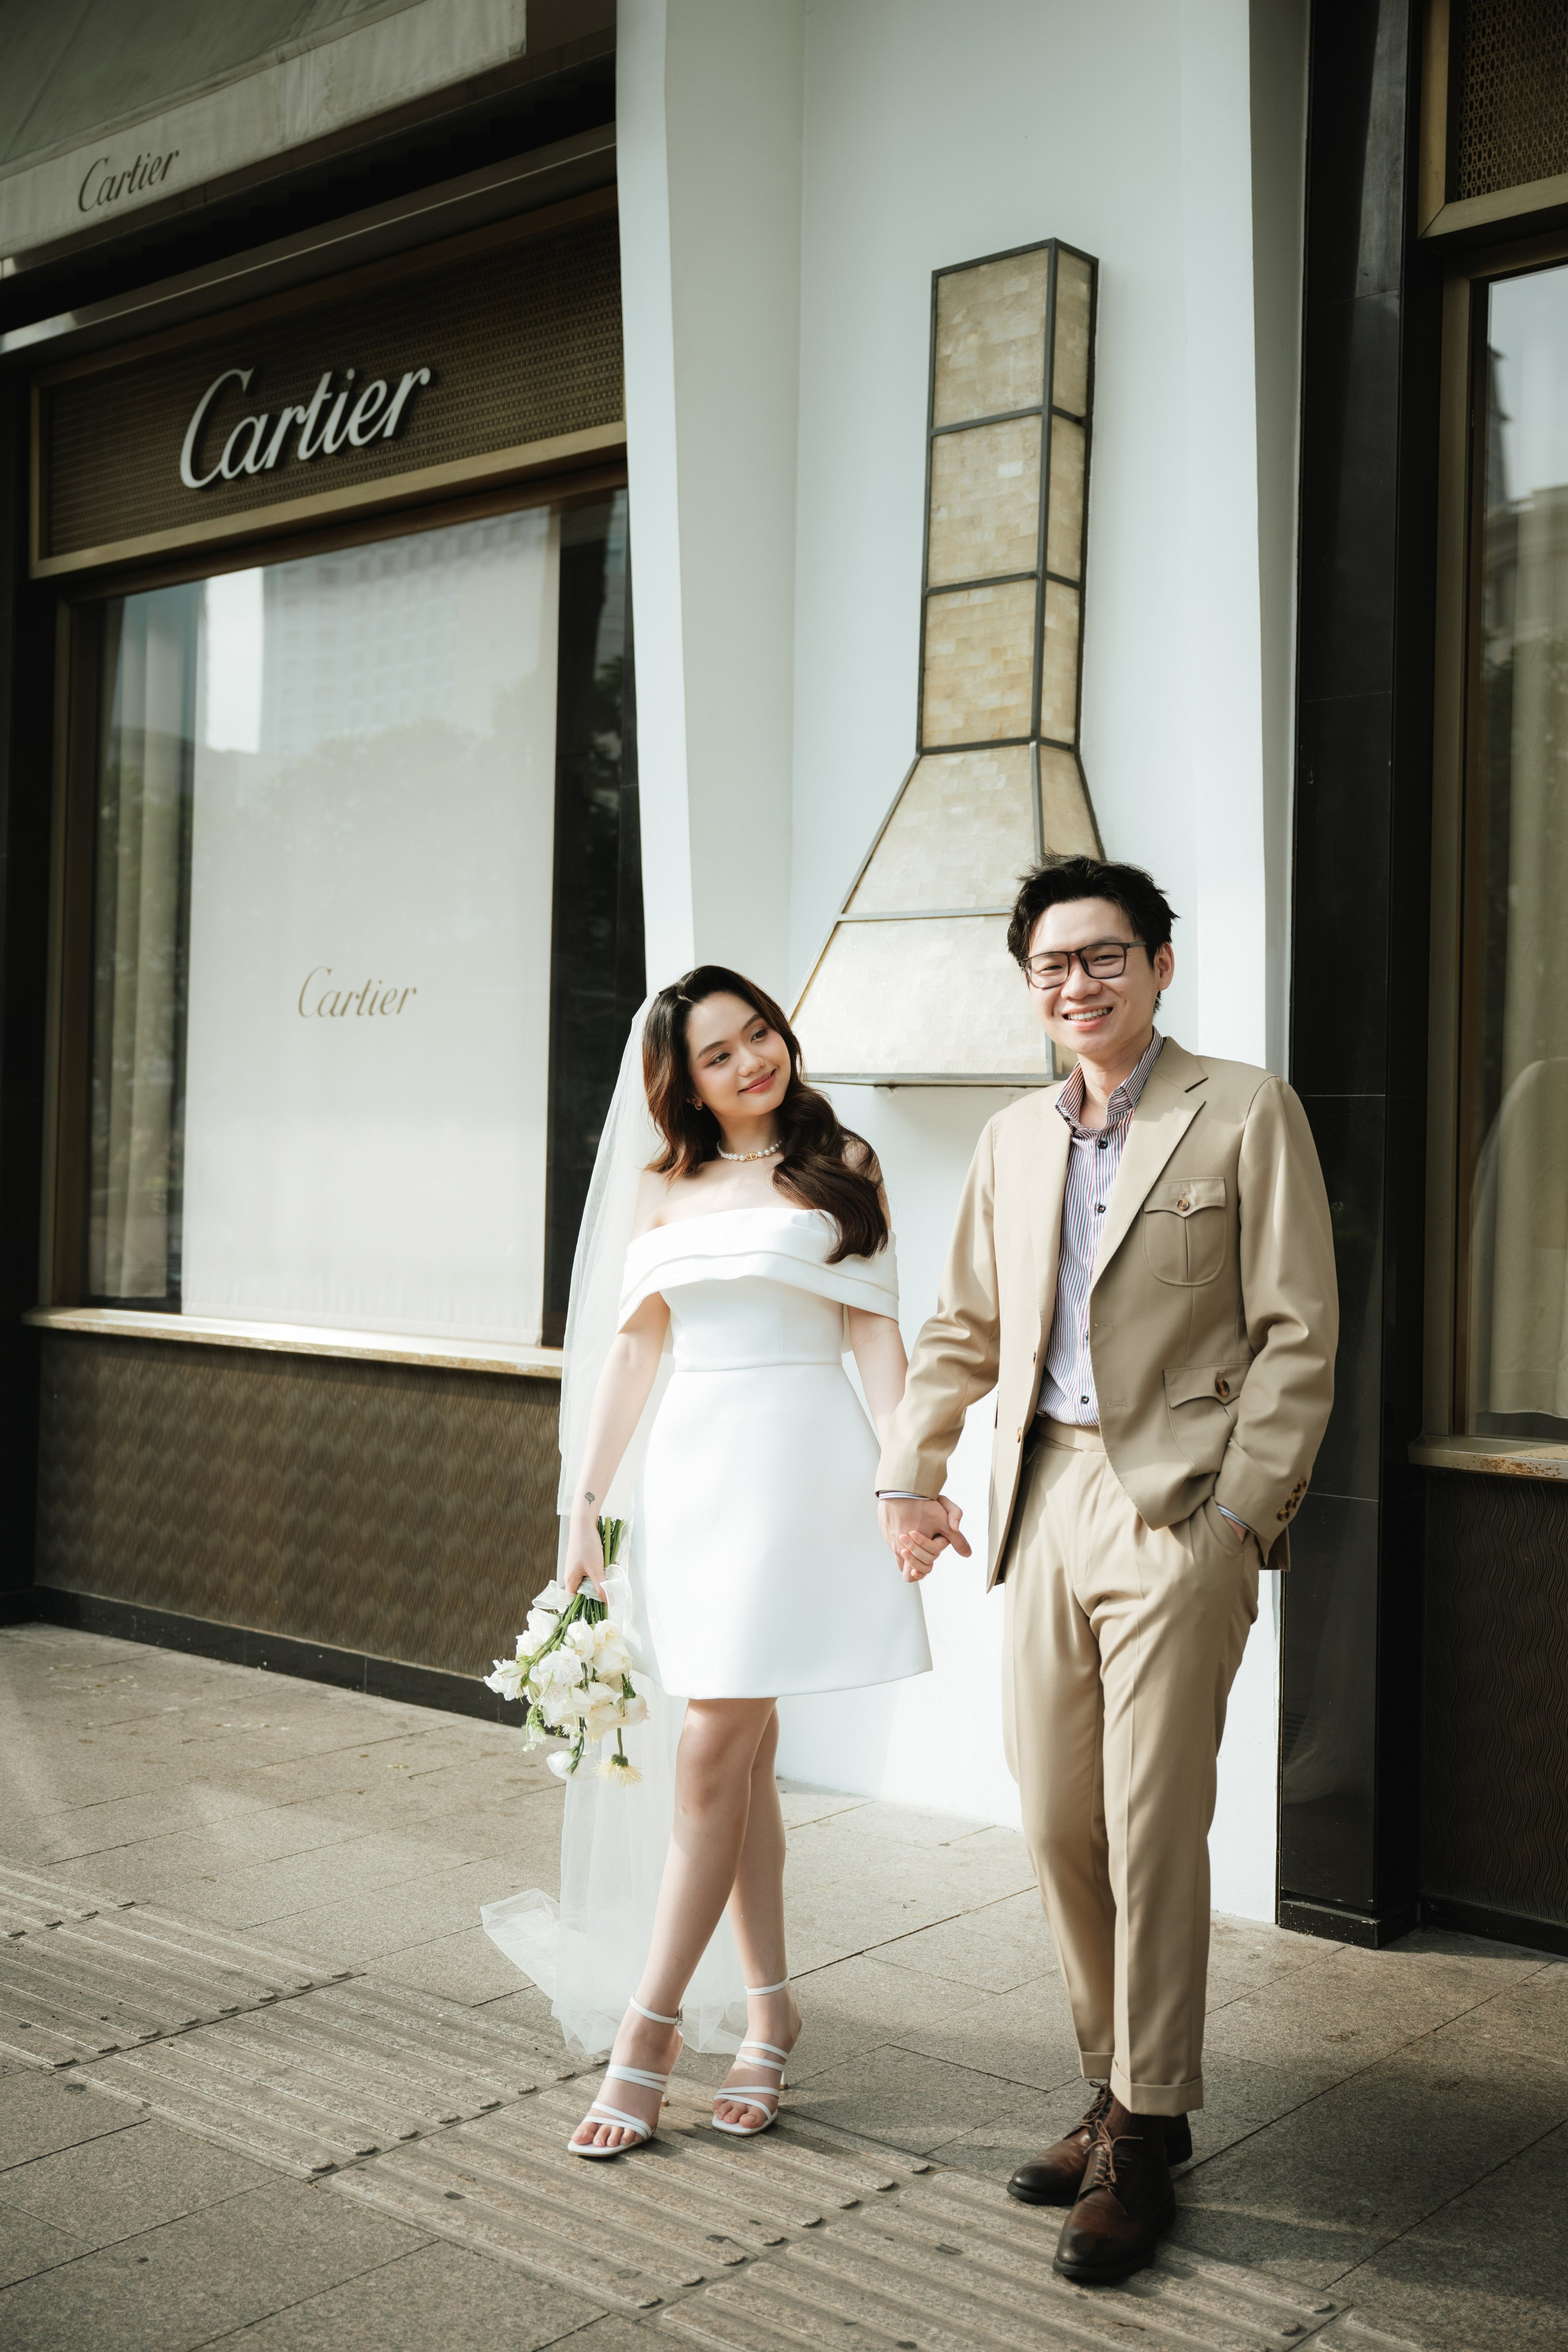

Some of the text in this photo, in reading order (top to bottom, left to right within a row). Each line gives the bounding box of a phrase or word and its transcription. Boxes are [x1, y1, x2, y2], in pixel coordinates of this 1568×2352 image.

[78, 149, 180, 212] Cartier
[180, 368, 431, 489] Cartier
[298, 965, 417, 1018] Cartier
